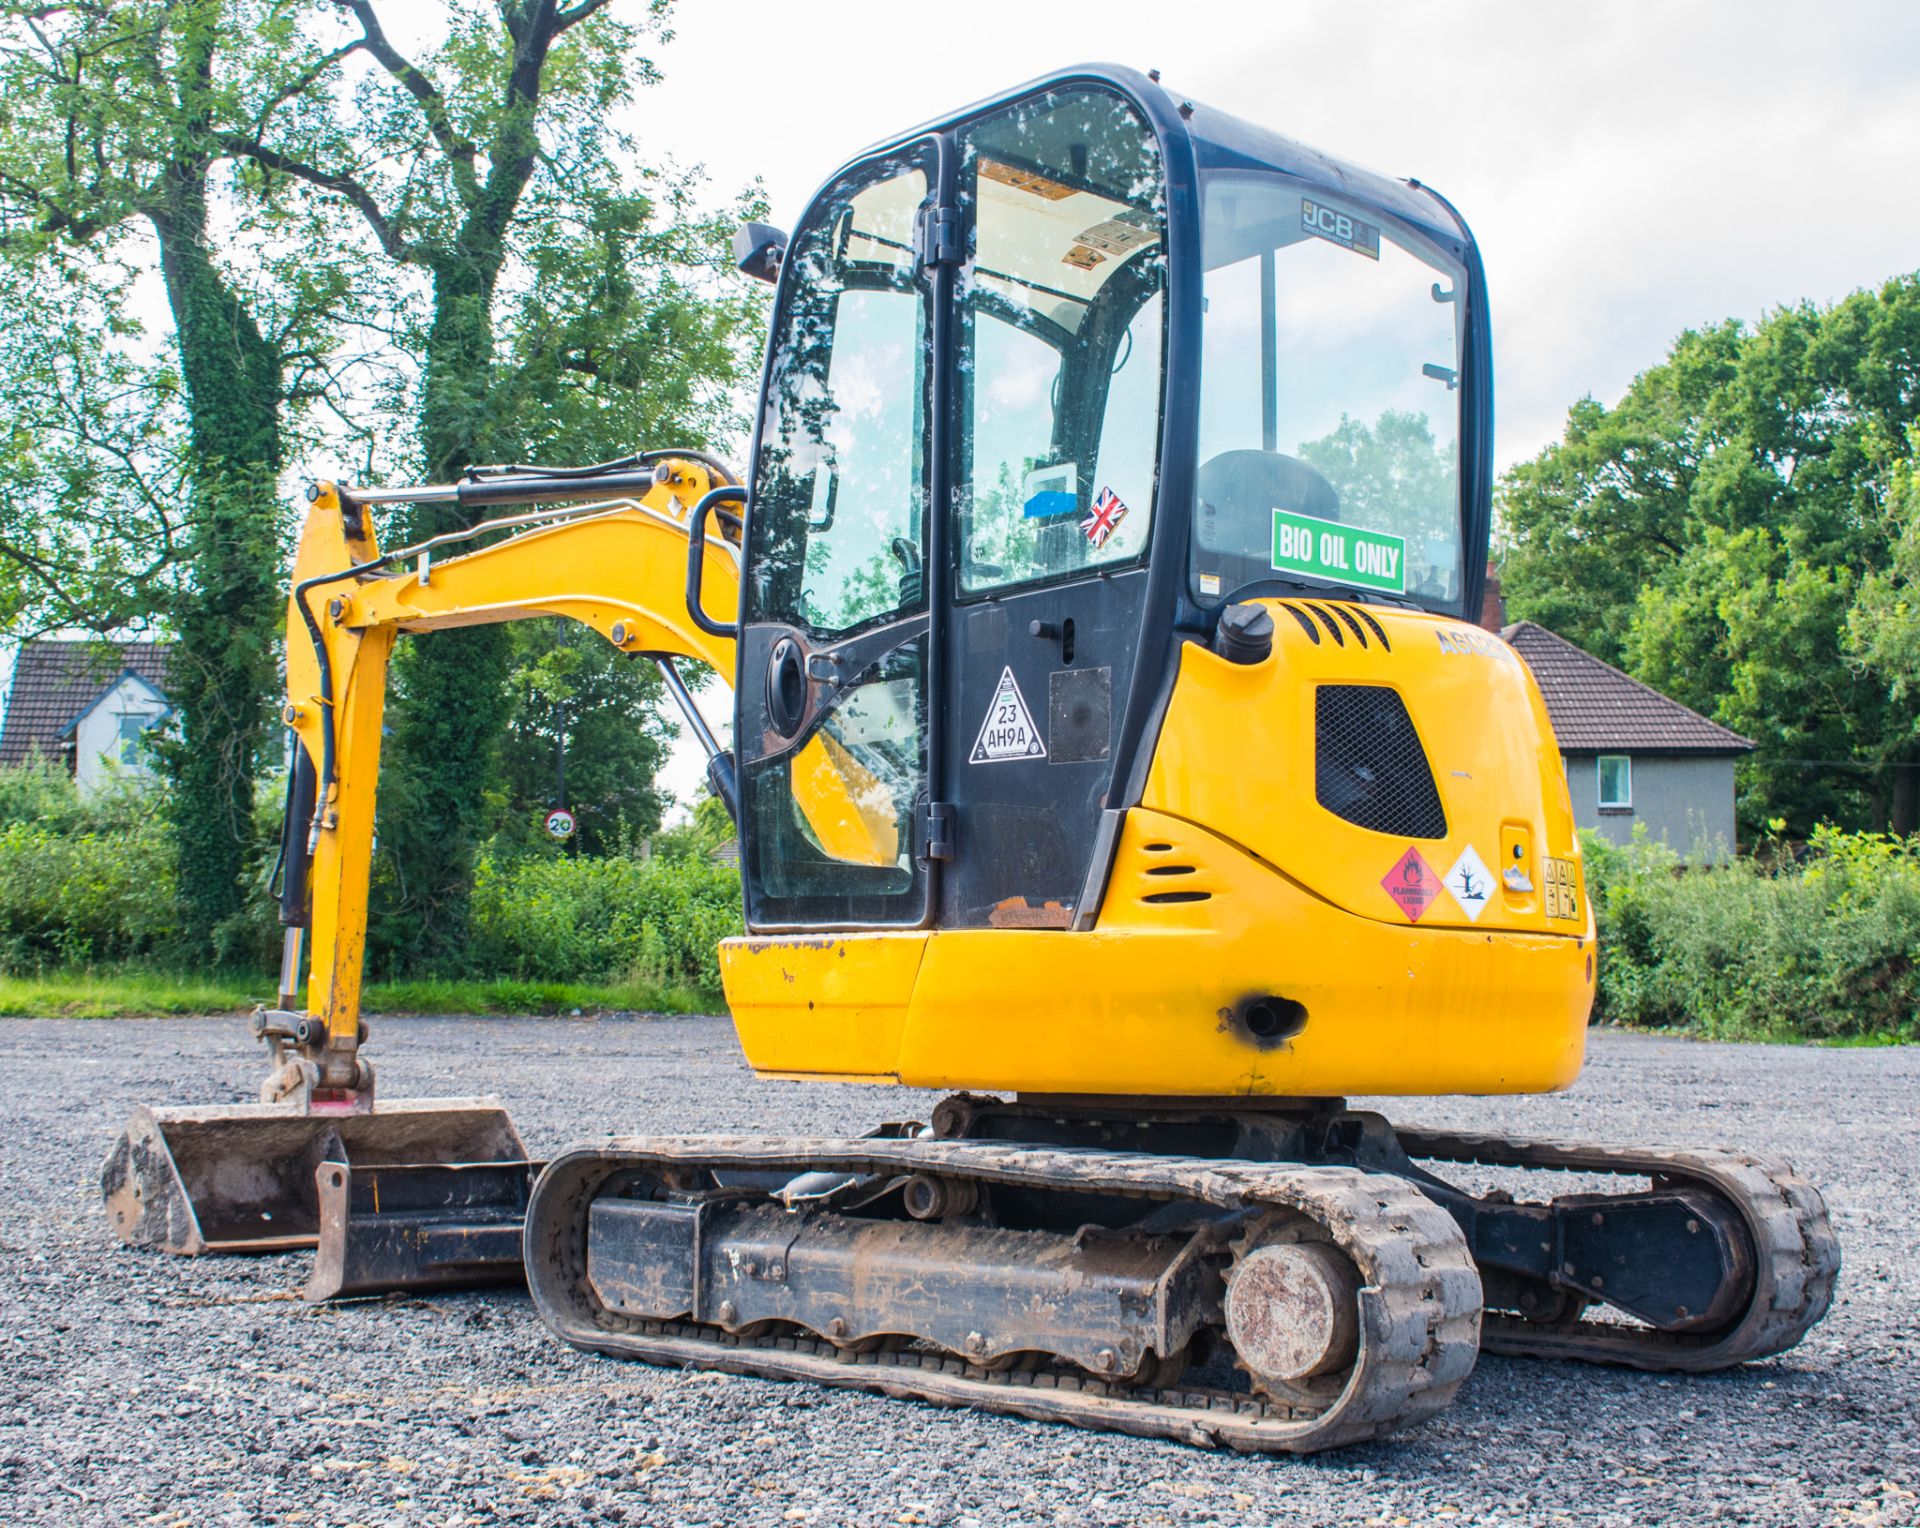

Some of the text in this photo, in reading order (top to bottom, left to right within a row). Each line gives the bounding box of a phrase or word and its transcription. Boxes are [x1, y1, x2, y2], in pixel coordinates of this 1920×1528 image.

[1303, 204, 1353, 240] JCB
[1280, 524, 1399, 579] BIO OIL ONLY
[998, 705, 1016, 724] 23
[988, 727, 1026, 748] AH9A
[550, 818, 571, 831] 20
